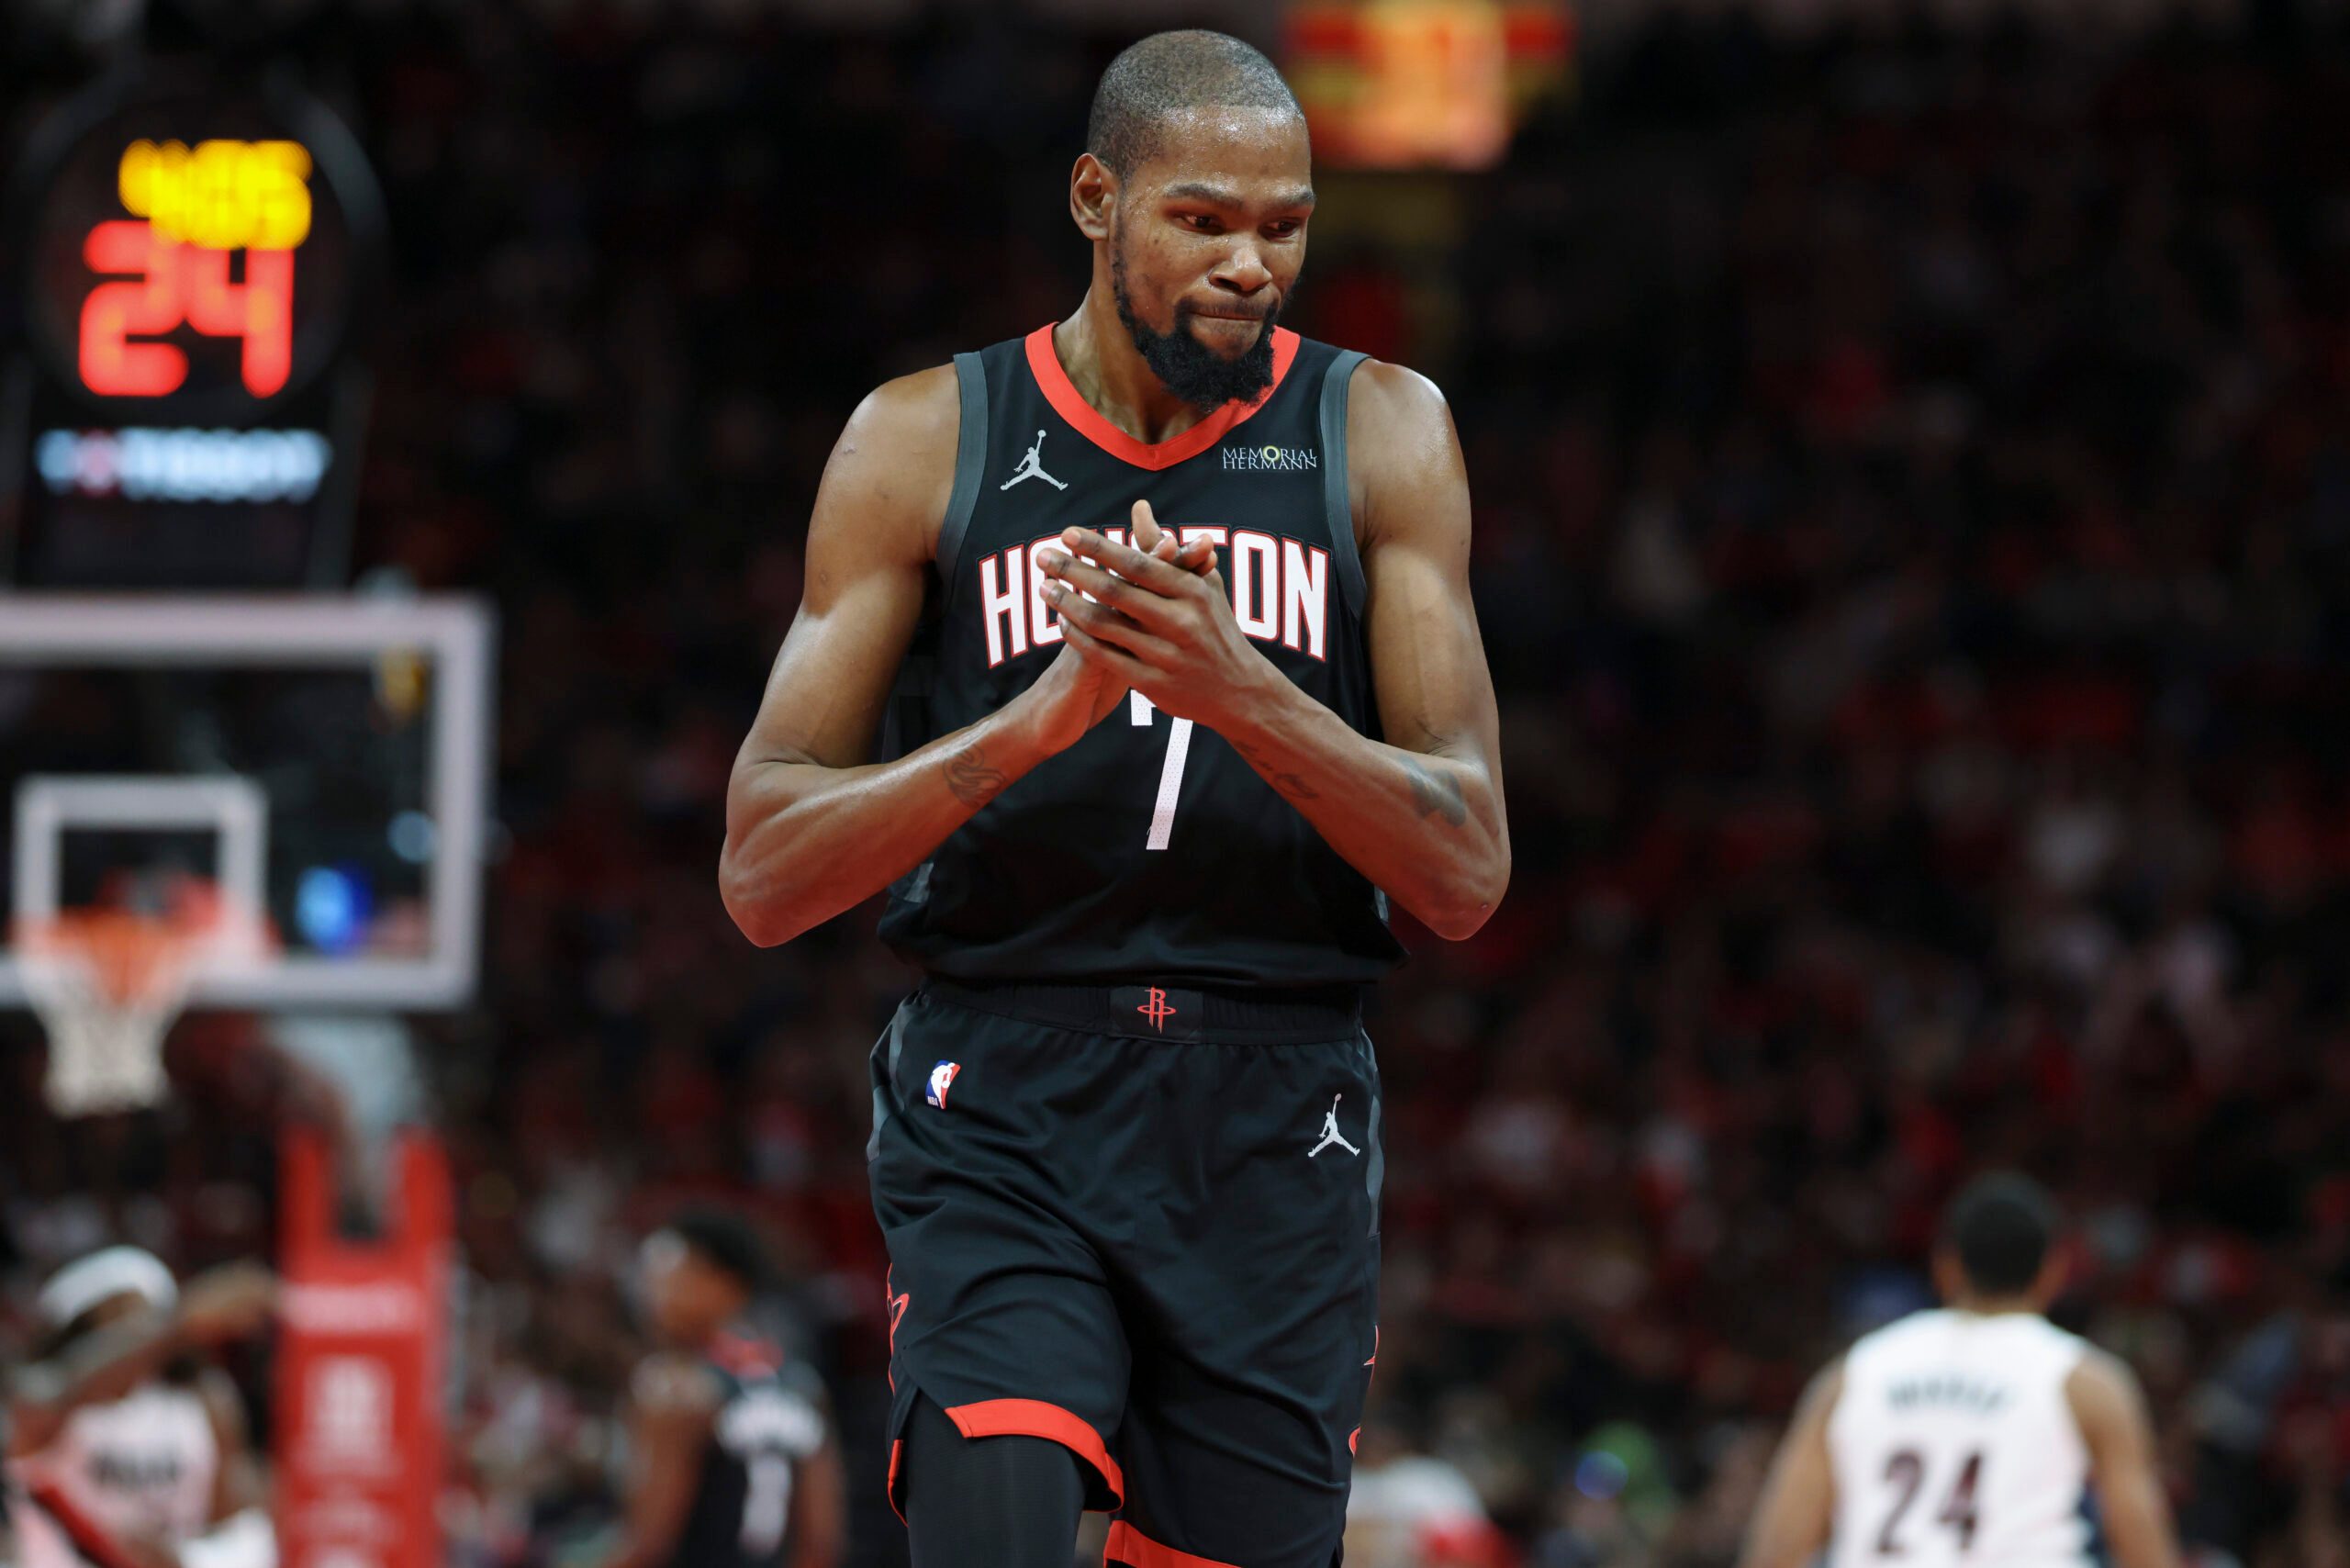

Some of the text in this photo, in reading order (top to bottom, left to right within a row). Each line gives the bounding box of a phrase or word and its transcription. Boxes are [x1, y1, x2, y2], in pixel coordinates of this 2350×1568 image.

[79, 220, 295, 398] 24
[1223, 445, 1317, 461] MEMORIAL
[1223, 457, 1317, 470] HERMANN
[978, 526, 1331, 670] HOON
[1874, 1443, 1984, 1557] 24
